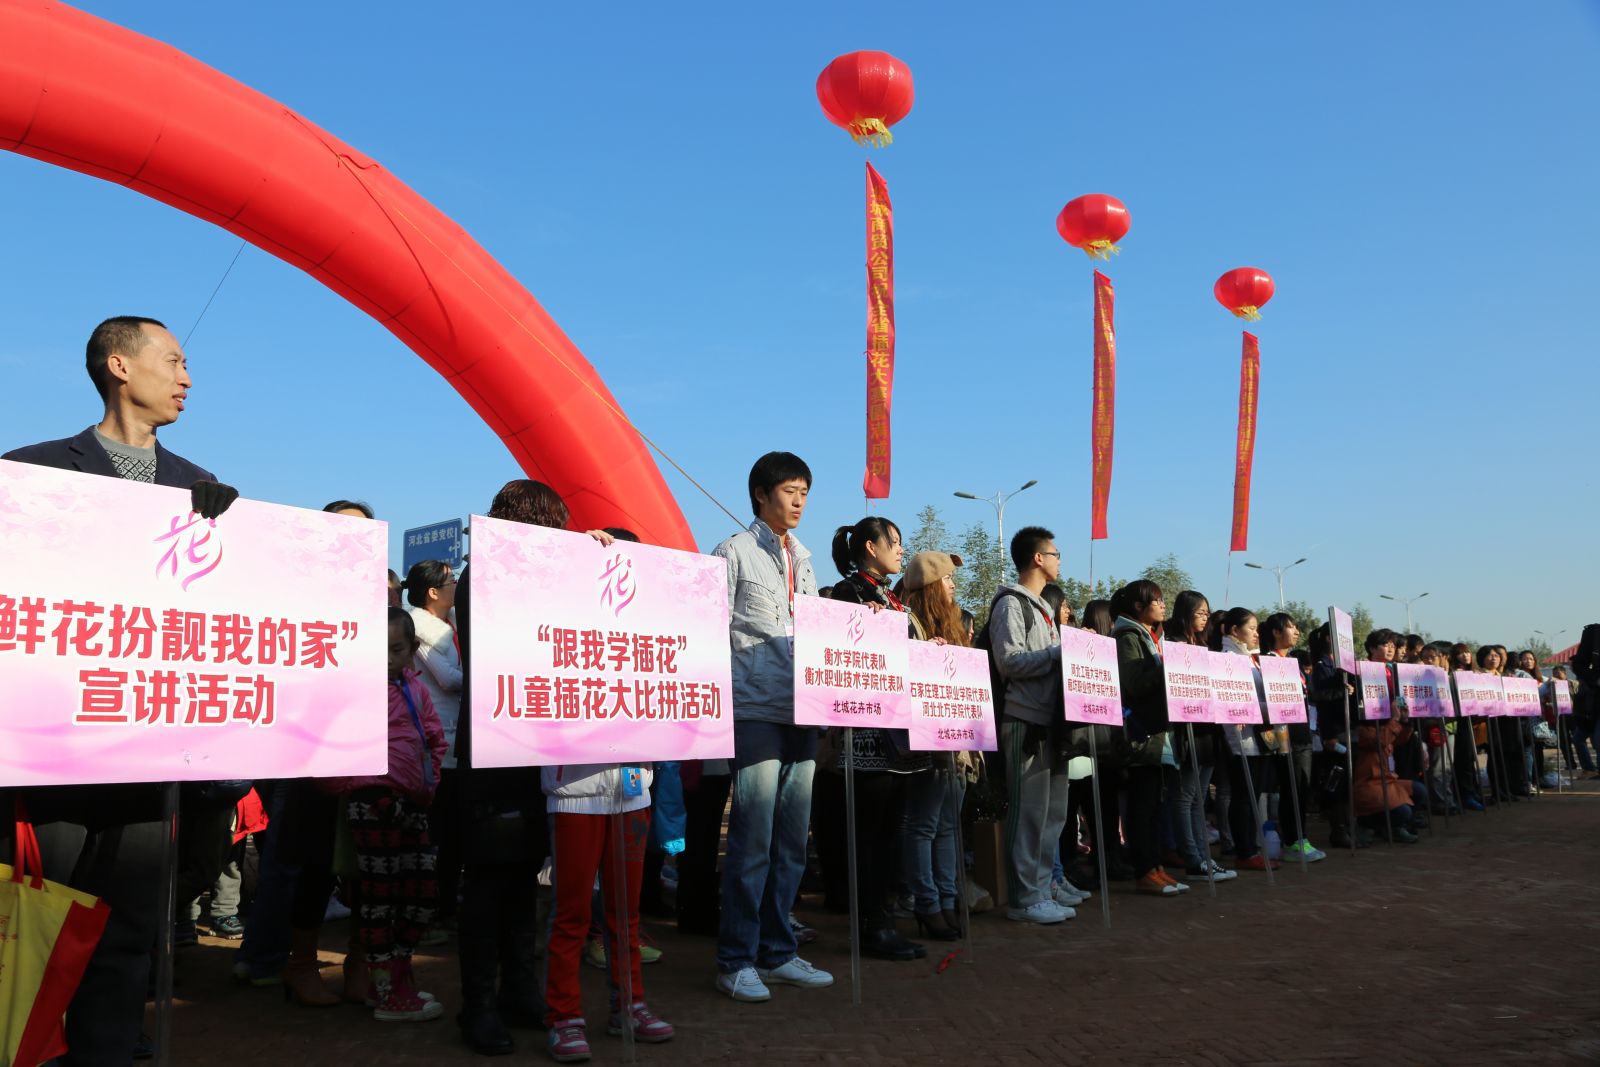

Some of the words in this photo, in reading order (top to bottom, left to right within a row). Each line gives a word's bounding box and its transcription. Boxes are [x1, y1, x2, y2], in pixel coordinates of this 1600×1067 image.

[408, 527, 454, 547] 河北省委党校
[537, 623, 687, 673] “跟我学插花”
[824, 647, 887, 671] 衡水学院代表队
[804, 667, 904, 692] 衡水职业技术学院代表队
[76, 667, 276, 726] 宣讲活动
[493, 675, 721, 721] 儿童插花大比拼活动
[910, 681, 991, 703] 石家庄理工职业学院代表队
[833, 700, 882, 715] 北城花卉市场
[922, 701, 984, 720] 河北北方学院代表队
[938, 728, 975, 741] 北城花卉市场
